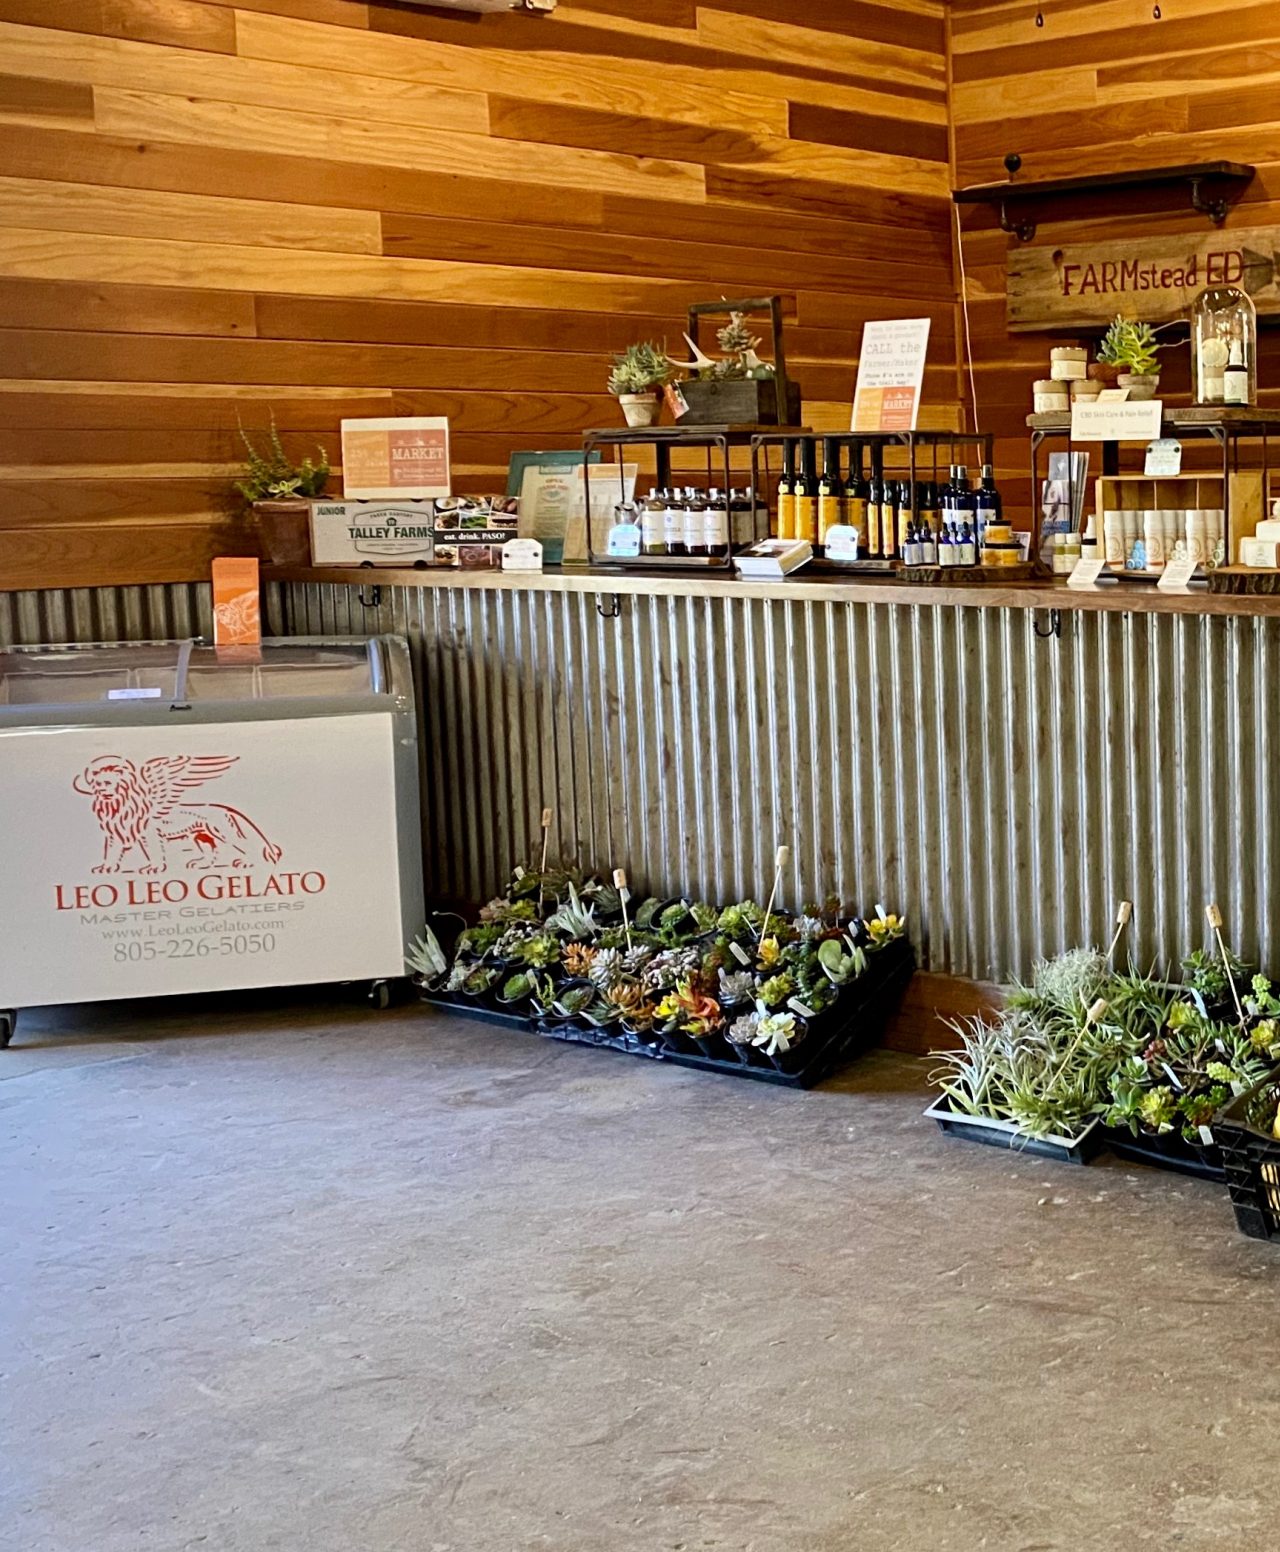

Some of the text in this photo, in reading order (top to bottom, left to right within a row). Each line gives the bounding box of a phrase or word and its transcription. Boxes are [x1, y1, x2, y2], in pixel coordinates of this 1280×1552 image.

[1062, 251, 1243, 296] FARMstead ED
[865, 342, 921, 355] CALL the
[392, 447, 444, 460] MARKET
[317, 506, 346, 516] JUNIOR
[349, 526, 435, 539] TALLEY FARMS
[443, 532, 506, 541] eat. drink. PASO!
[54, 871, 326, 910] LEO LEO GELATO
[79, 901, 305, 925] MASTER GELATIERS
[101, 918, 285, 941] www.LeoLeoGelato.com
[113, 933, 276, 962] 805-226-5050
